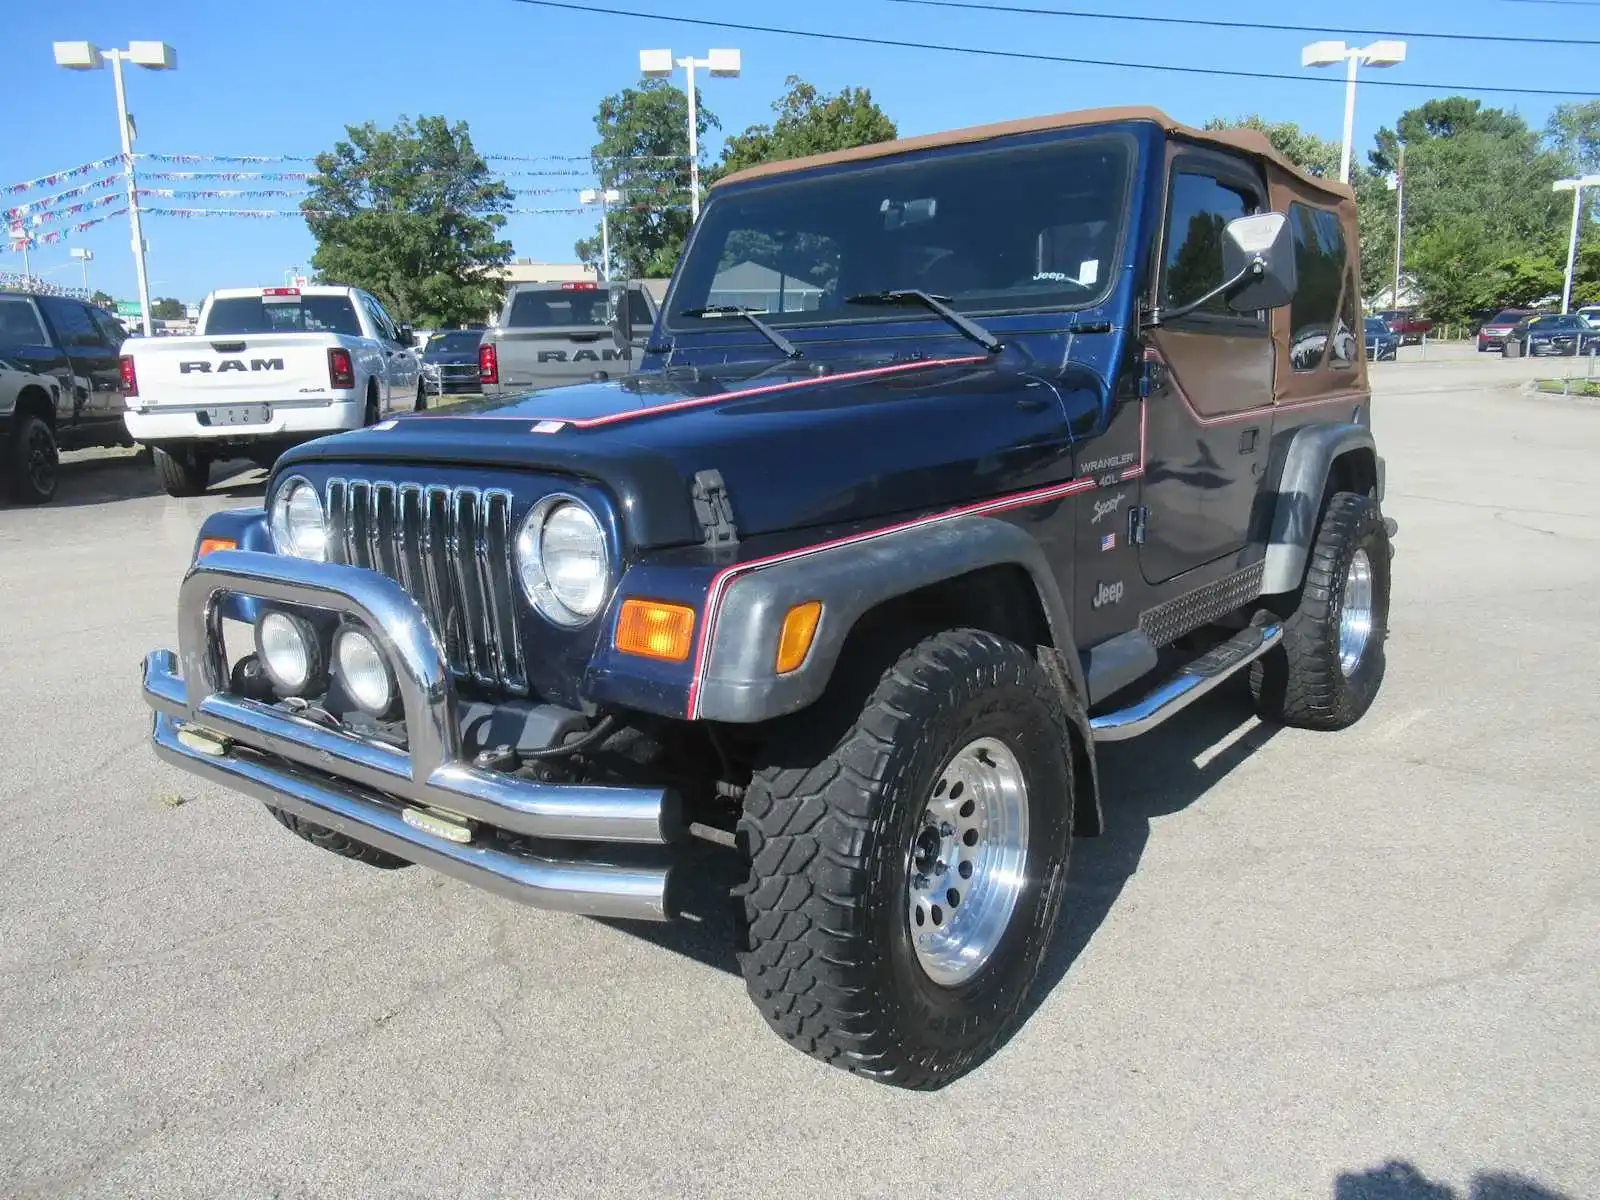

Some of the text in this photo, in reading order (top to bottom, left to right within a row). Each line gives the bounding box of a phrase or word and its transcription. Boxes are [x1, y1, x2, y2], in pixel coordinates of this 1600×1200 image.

[1033, 272, 1065, 281] Jeep
[537, 348, 632, 363] RAM
[179, 358, 284, 374] RAM
[1080, 453, 1134, 472] WRANGLER
[1091, 492, 1126, 524] Sport
[1093, 580, 1124, 607] Jeep
